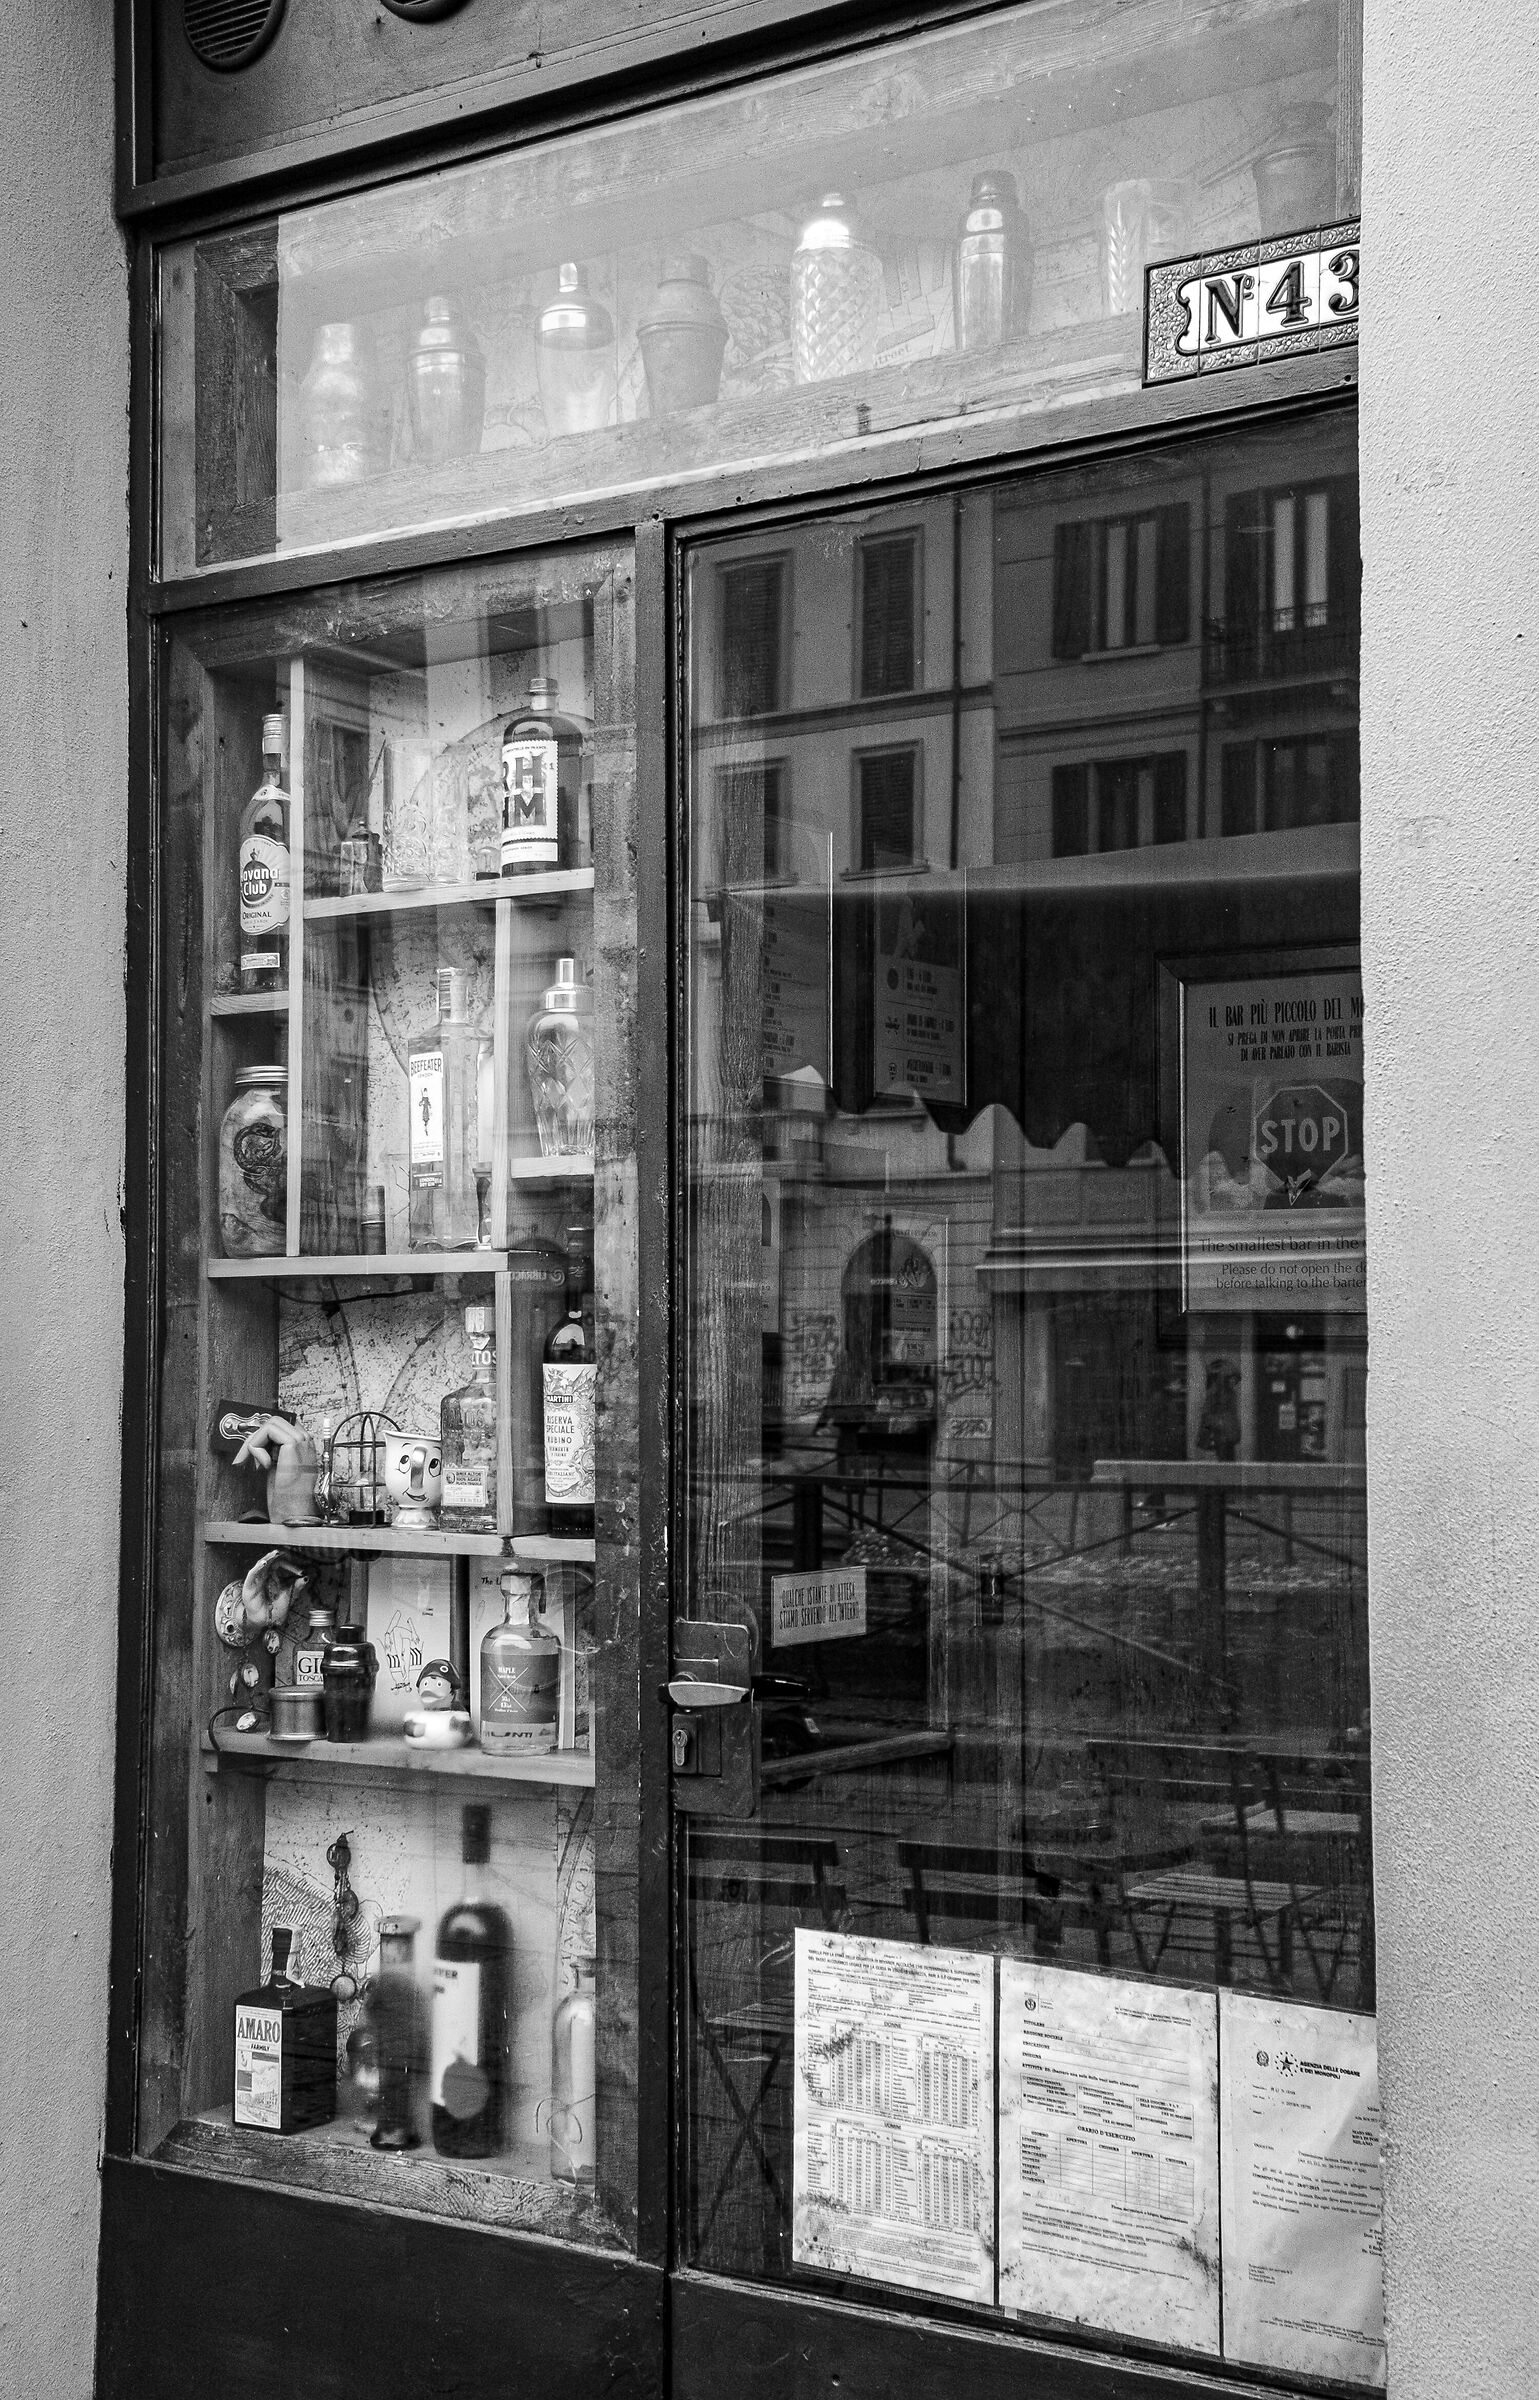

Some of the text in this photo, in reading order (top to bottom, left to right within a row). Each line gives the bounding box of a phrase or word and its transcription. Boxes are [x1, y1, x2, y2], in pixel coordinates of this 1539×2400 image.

[242, 867, 280, 881] avana
[243, 881, 268, 896] Club
[242, 911, 272, 921] ORIGINAL
[1209, 1006, 1219, 1028] IL
[1226, 1004, 1244, 1027] BAR
[1251, 998, 1268, 1026] PIÙ
[1275, 1000, 1316, 1024] PICCOLO
[1324, 998, 1343, 1021] DEL
[1227, 1033, 1234, 1046] SI
[1237, 1031, 1257, 1045] PREGA
[1260, 1030, 1268, 1044] DI
[1272, 1029, 1285, 1043] NON
[1289, 1027, 1310, 1042] APRIRE
[1314, 1027, 1322, 1041] LA
[1326, 1025, 1346, 1040] PORTA
[1240, 1041, 1351, 1062] DI AVER PARLATO CON IL BARISTA
[410, 1058, 442, 1077] BEEFEATER
[1260, 1116, 1341, 1154] STOP
[1199, 1236, 1360, 1252] The smallest bar in the
[1222, 1263, 1257, 1276] Please
[1260, 1263, 1276, 1275] do
[1279, 1263, 1298, 1275] not
[1301, 1264, 1330, 1277] open
[1334, 1261, 1352, 1274] the
[1216, 1277, 1252, 1290] before
[1255, 1276, 1294, 1292] talking
[1297, 1278, 1308, 1289] to
[1311, 1277, 1330, 1289] the
[546, 1395, 574, 1404] MARTINI
[547, 1415, 573, 1425] RISERVA
[546, 1425, 575, 1434] SPECIALE
[547, 1436, 572, 1444] RUBINO
[481, 1577, 494, 1586] The
[782, 1587, 804, 1609] QUALCHE
[807, 1585, 827, 1606] ISTANTE
[830, 1584, 836, 1602] DI
[779, 1609, 798, 1630] STIAMO
[801, 1605, 826, 1627] SERVENDO
[298, 1656, 323, 1675] GI
[237, 2016, 281, 2044] AMARO
[884, 2021, 902, 2029] DONNE
[1300, 2061, 1361, 2077] AGENZIA DELLE DOGANE
[1314, 2070, 1341, 2080] MONOPOLI
[1077, 2125, 1099, 2135] ORARIO
